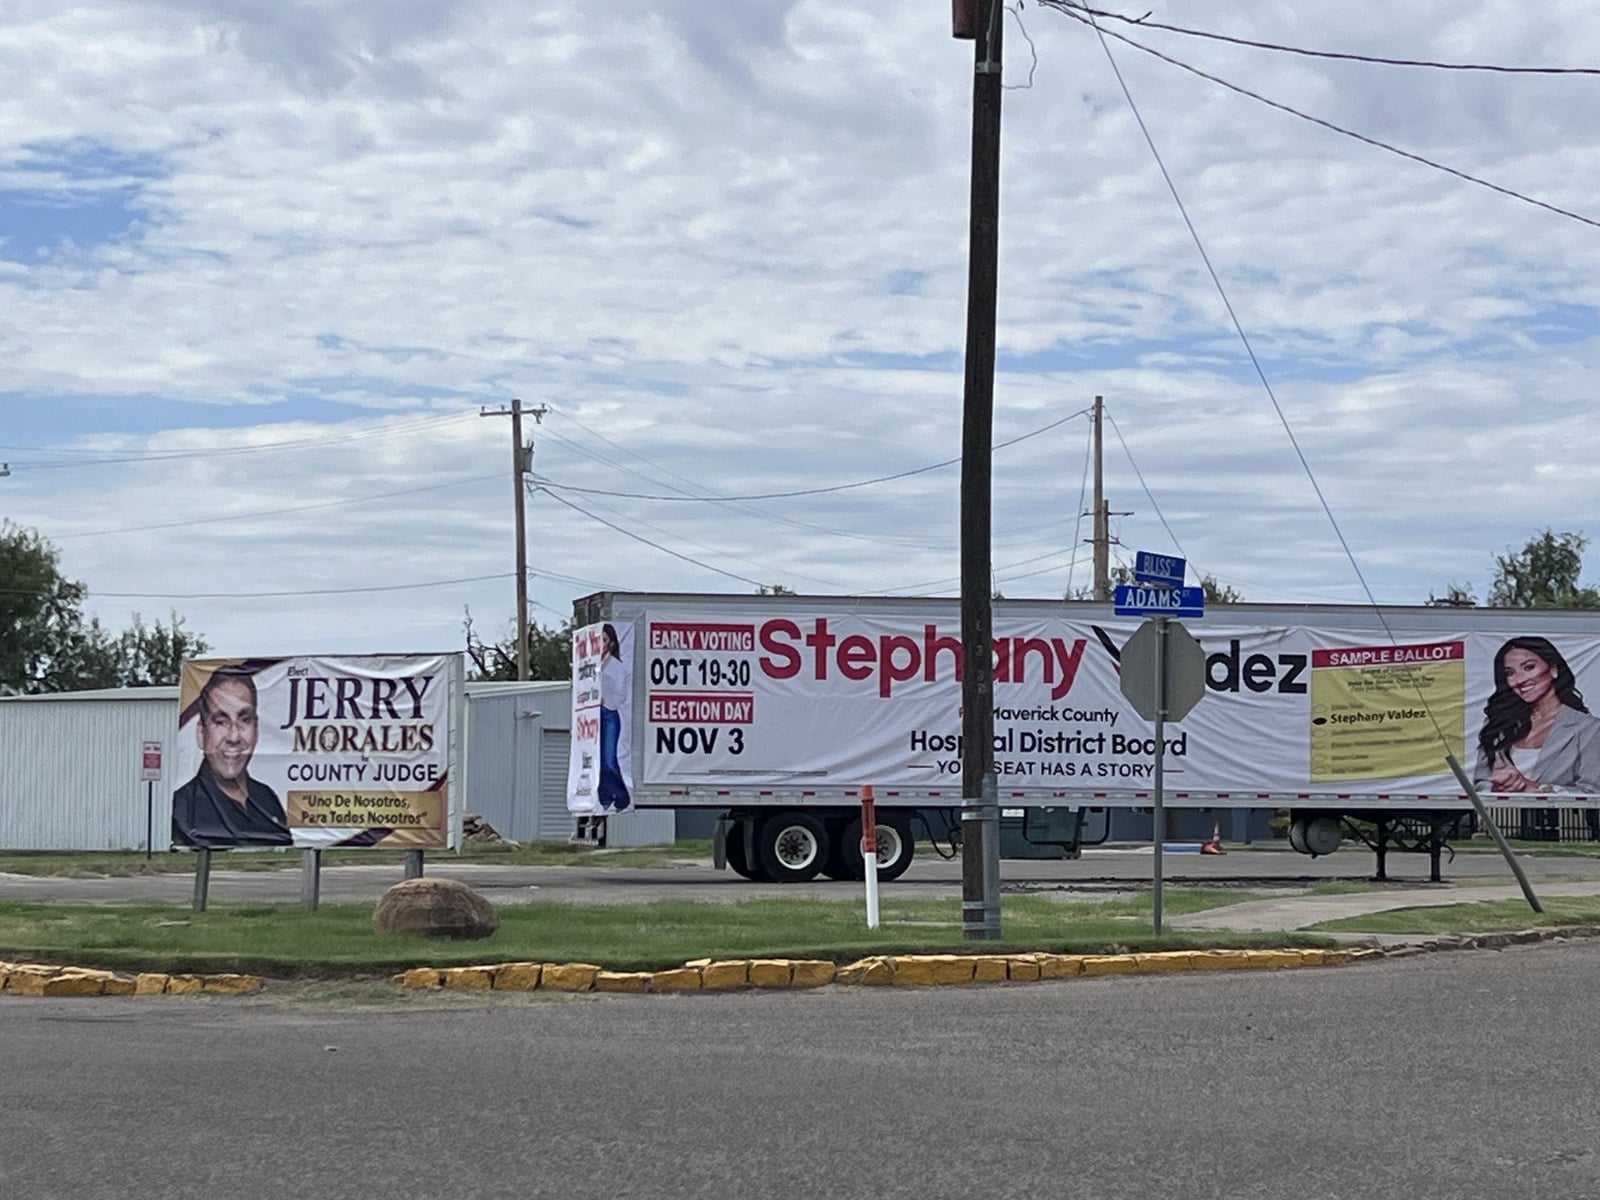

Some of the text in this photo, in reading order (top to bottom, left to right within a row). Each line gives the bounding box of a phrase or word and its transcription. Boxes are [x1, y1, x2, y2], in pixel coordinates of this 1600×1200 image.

[1143, 555, 1171, 576] BLISS
[1125, 589, 1181, 607] ADAMS
[652, 630, 752, 650] EARLY VOTING
[1330, 646, 1453, 665] SAMPLE BALLOT
[651, 658, 750, 686] OCT 19-30
[280, 676, 434, 729] JERRY
[652, 700, 751, 720] ELECTION DAY
[1062, 708, 1119, 727] County
[1330, 708, 1426, 725] Stephany Valdez
[292, 724, 434, 752] MORALES
[656, 727, 744, 755] NOV 3
[911, 728, 1013, 759] Hosal
[1020, 729, 1106, 754] District
[287, 764, 439, 782] COUNTY JUDGE
[993, 761, 1036, 775] SEAT
[1041, 762, 1075, 776] HAS
[1080, 763, 1093, 776] A
[1097, 763, 1155, 778] STORY
[335, 795, 351, 807] De
[354, 795, 410, 809] Nosotros,
[302, 812, 327, 824] Para
[330, 811, 367, 824] Todos
